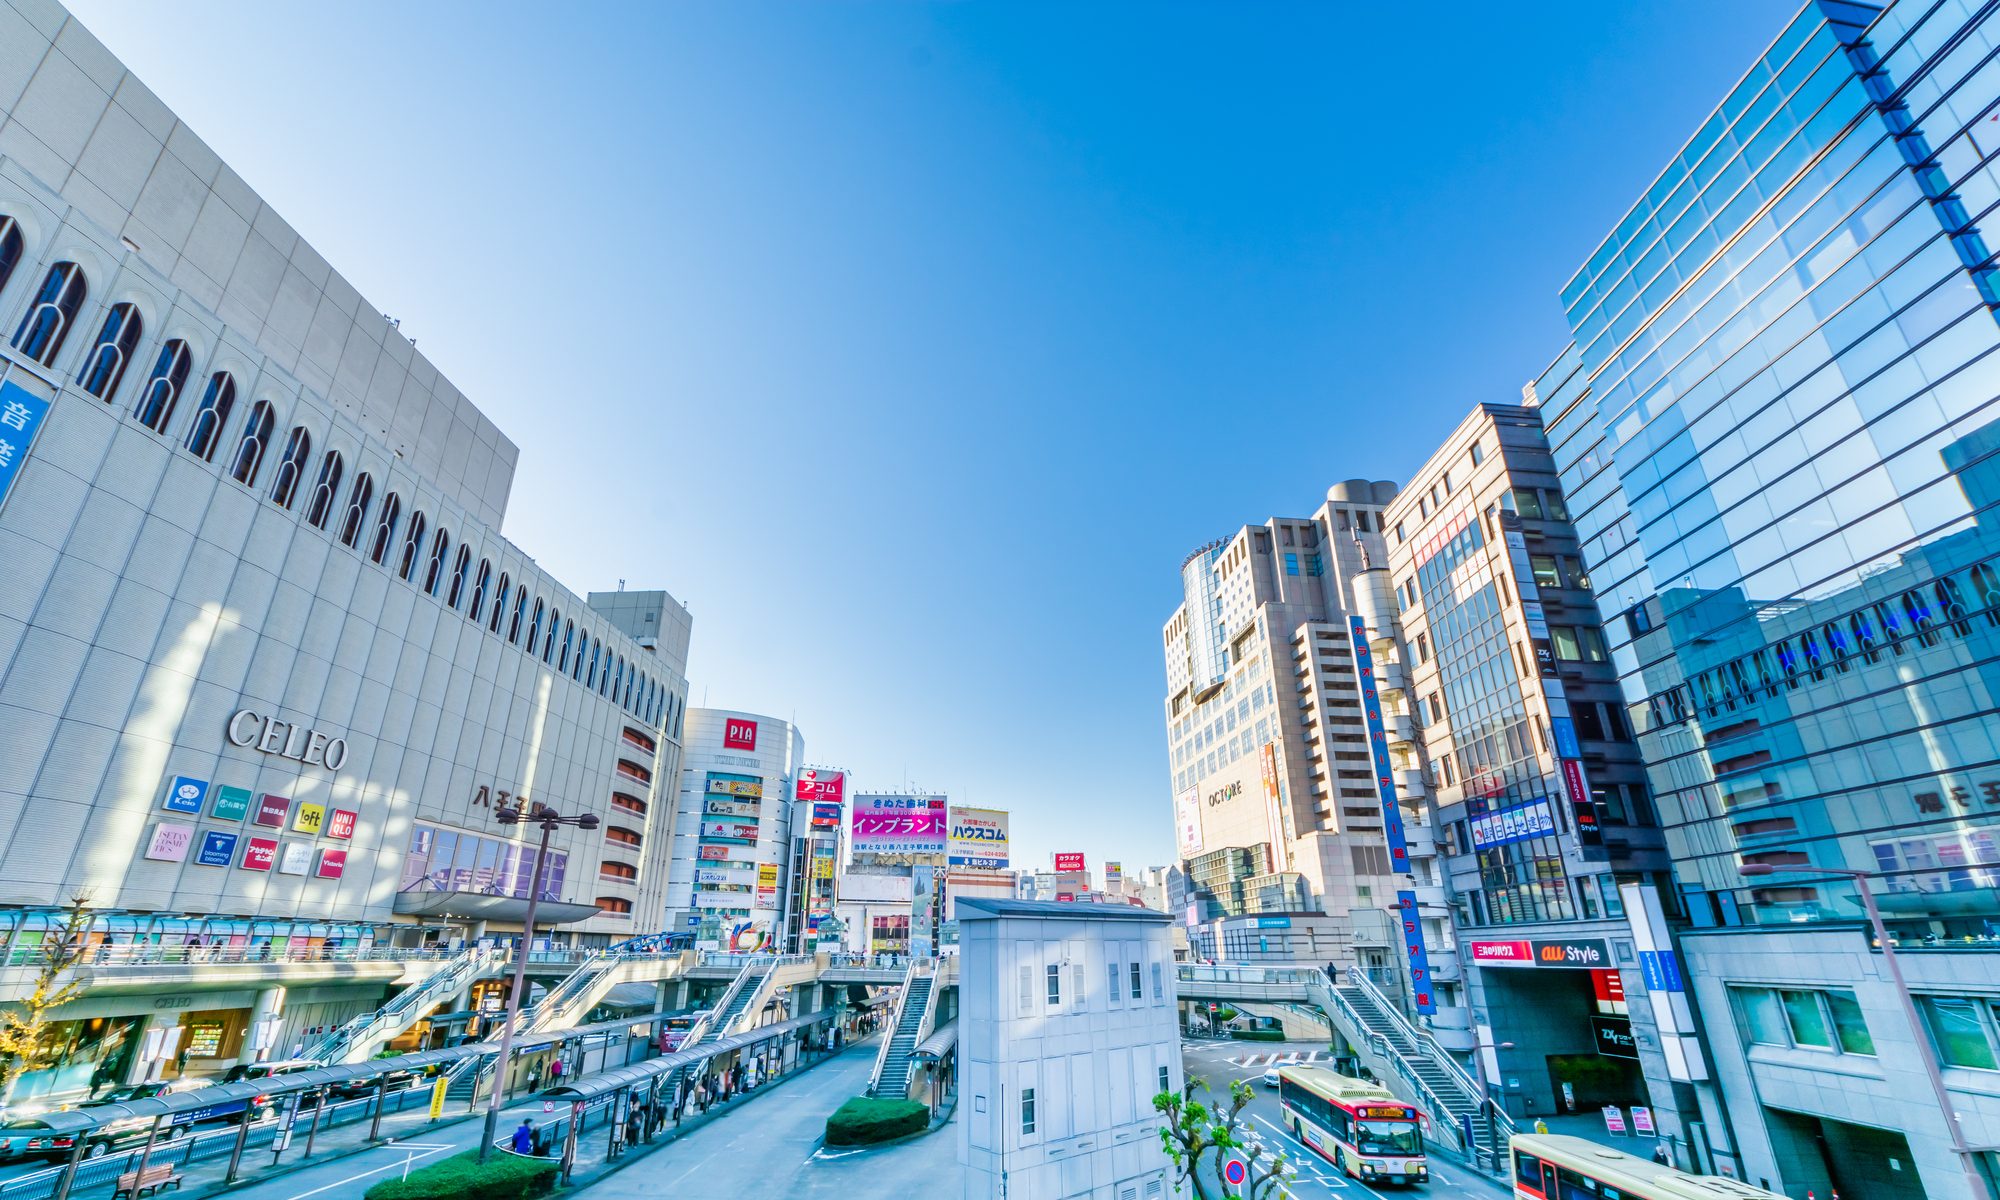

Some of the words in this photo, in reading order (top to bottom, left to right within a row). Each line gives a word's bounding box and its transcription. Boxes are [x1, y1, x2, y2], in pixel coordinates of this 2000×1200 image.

[730, 725, 752, 741] PIA
[228, 709, 349, 771] CELEO
[804, 781, 836, 794] アコム
[1208, 779, 1242, 807] OCTORE
[174, 796, 196, 807] Keio
[873, 799, 927, 809] きぬた歯科
[335, 812, 354, 825] UNI
[1579, 815, 1595, 823] au
[333, 824, 352, 836] QLO
[853, 817, 946, 834] インプラント
[1484, 814, 1552, 839] 朝日土地建物
[1581, 824, 1598, 832] Style
[953, 825, 1006, 841] ハウスコム
[204, 850, 230, 859] blooming
[1402, 899, 1429, 1006] カラオケ館
[1477, 945, 1514, 957] 三井のリハウス
[1541, 946, 1567, 962] au
[1566, 945, 1600, 964] Style
